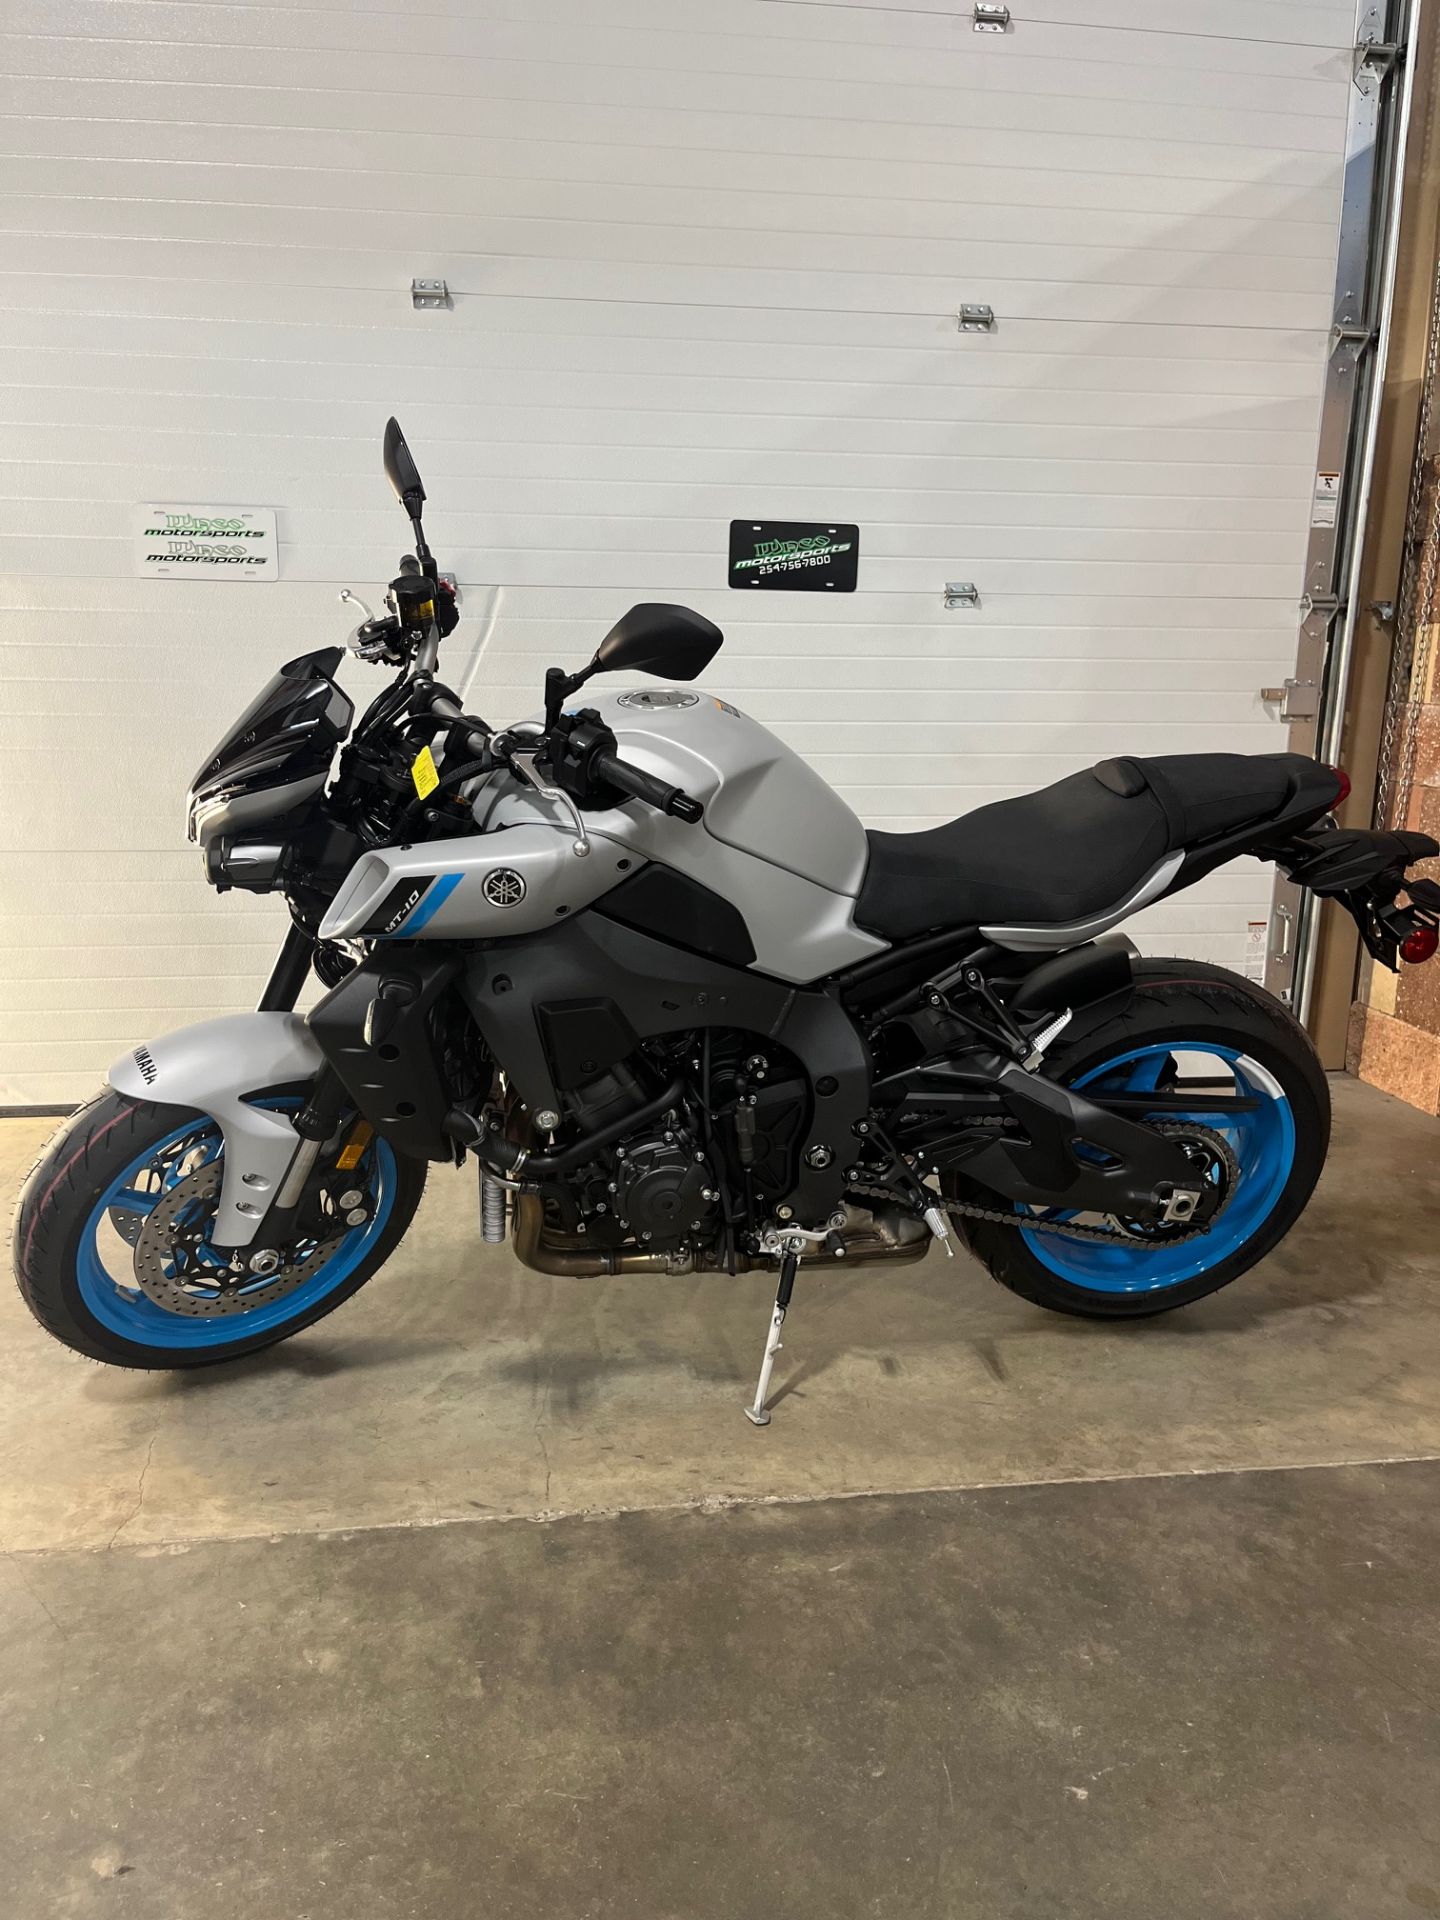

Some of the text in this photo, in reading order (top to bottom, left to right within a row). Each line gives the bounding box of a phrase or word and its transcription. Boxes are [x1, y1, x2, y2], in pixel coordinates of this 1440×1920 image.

[143, 529, 266, 538] motorsports
[145, 554, 268, 564] motorsports
[734, 542, 852, 570] motorsports
[758, 554, 832, 575] 254-756-7800
[384, 889, 420, 933] MT-10
